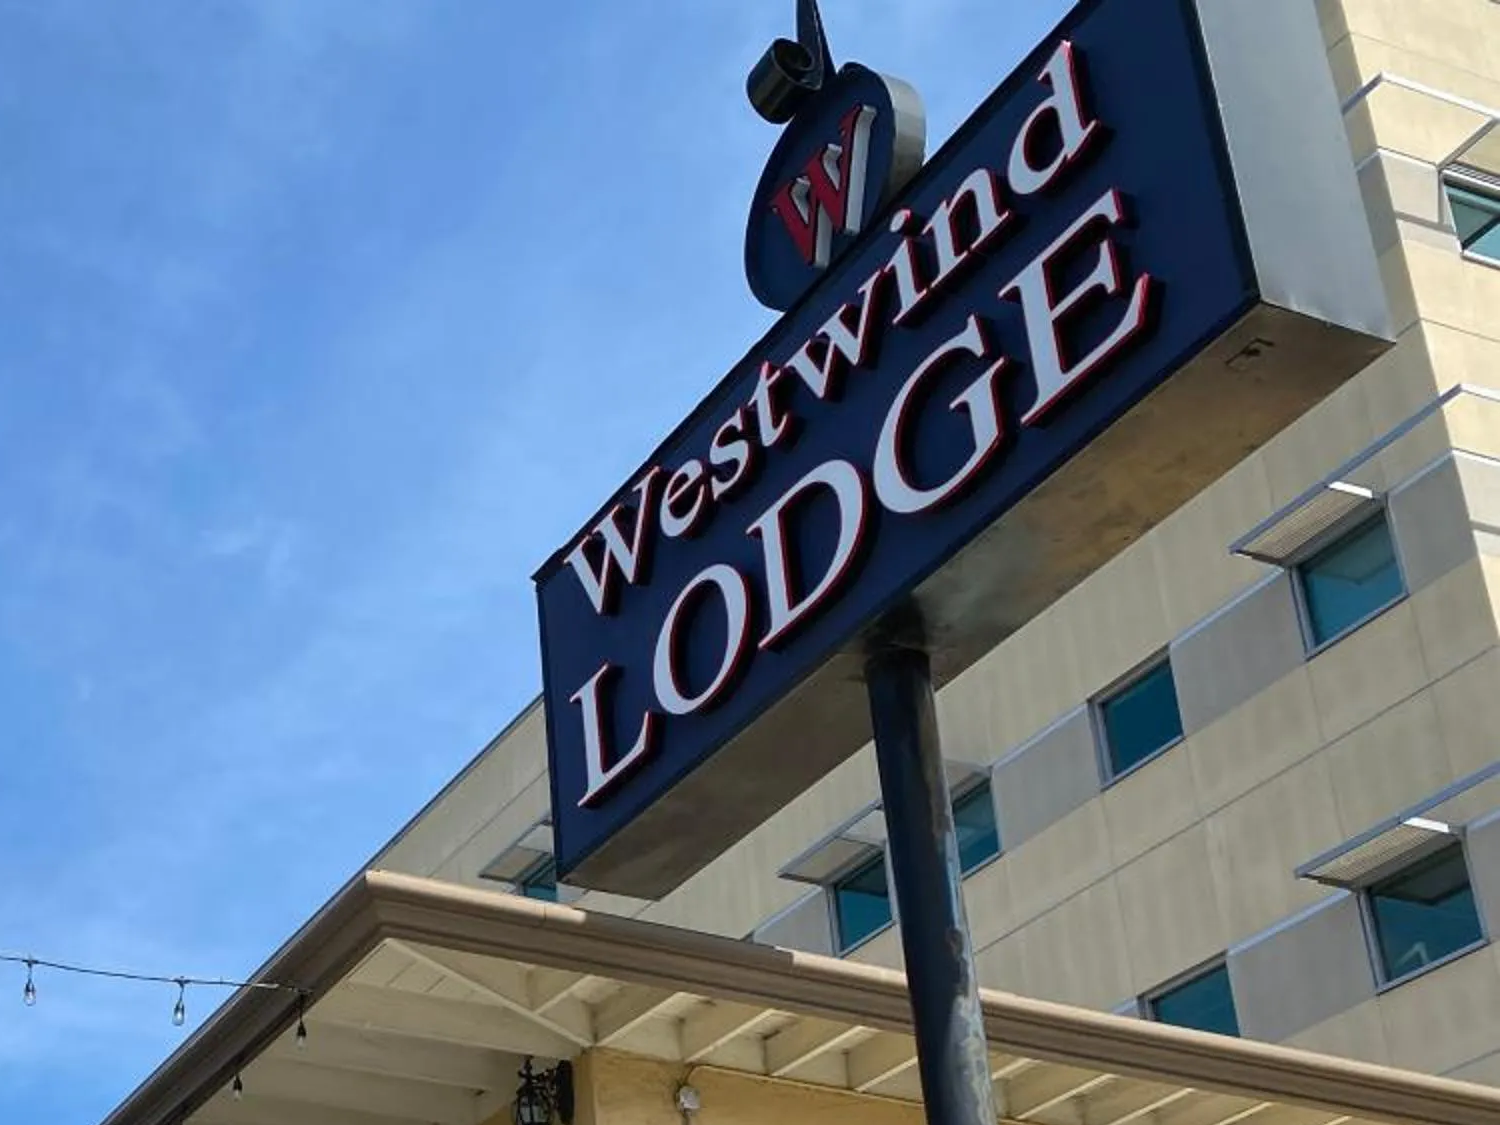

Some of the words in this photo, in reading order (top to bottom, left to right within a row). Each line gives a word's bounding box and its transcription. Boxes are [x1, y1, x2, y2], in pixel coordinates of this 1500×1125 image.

[563, 39, 1101, 616] Westwind
[771, 104, 874, 268] W
[569, 188, 1154, 808] LODGE
